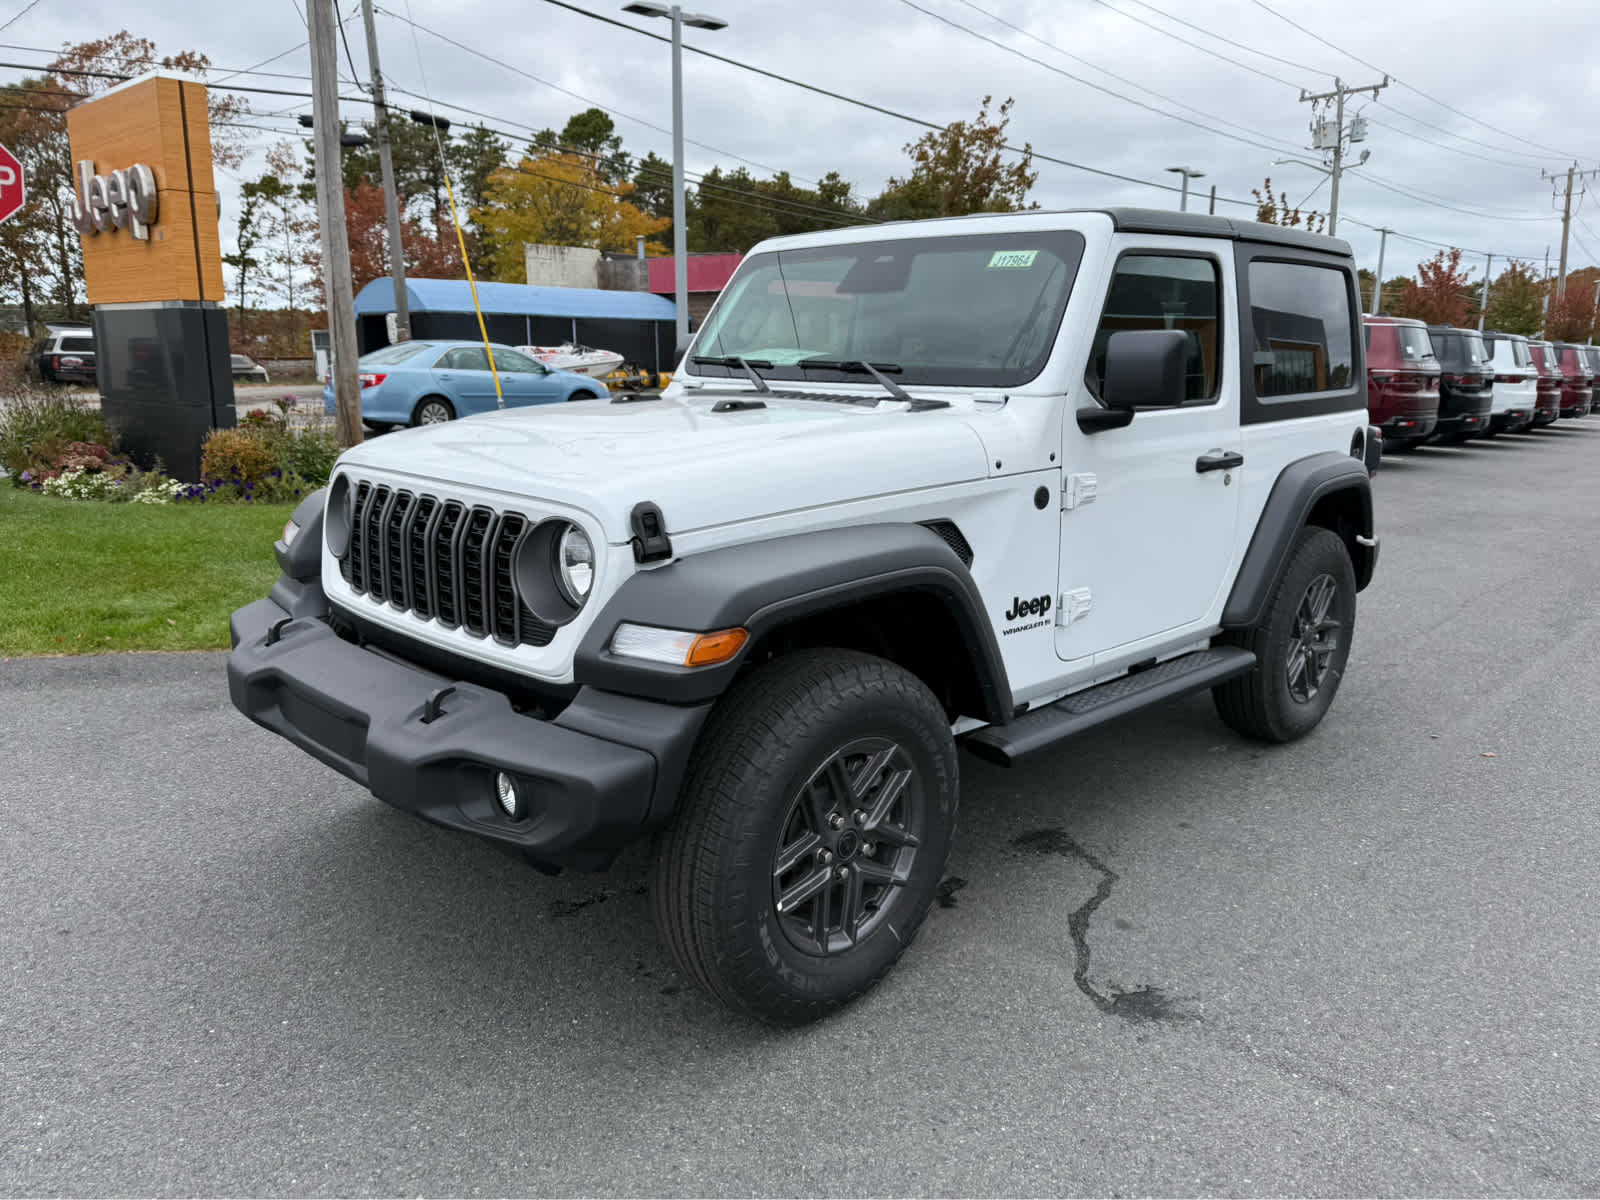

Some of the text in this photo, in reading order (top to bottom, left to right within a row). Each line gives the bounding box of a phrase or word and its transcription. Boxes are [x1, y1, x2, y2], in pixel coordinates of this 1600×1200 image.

[70, 160, 157, 240] Jeep
[1006, 595, 1051, 621] Jeep
[1003, 621, 1043, 637] WRANGLER
